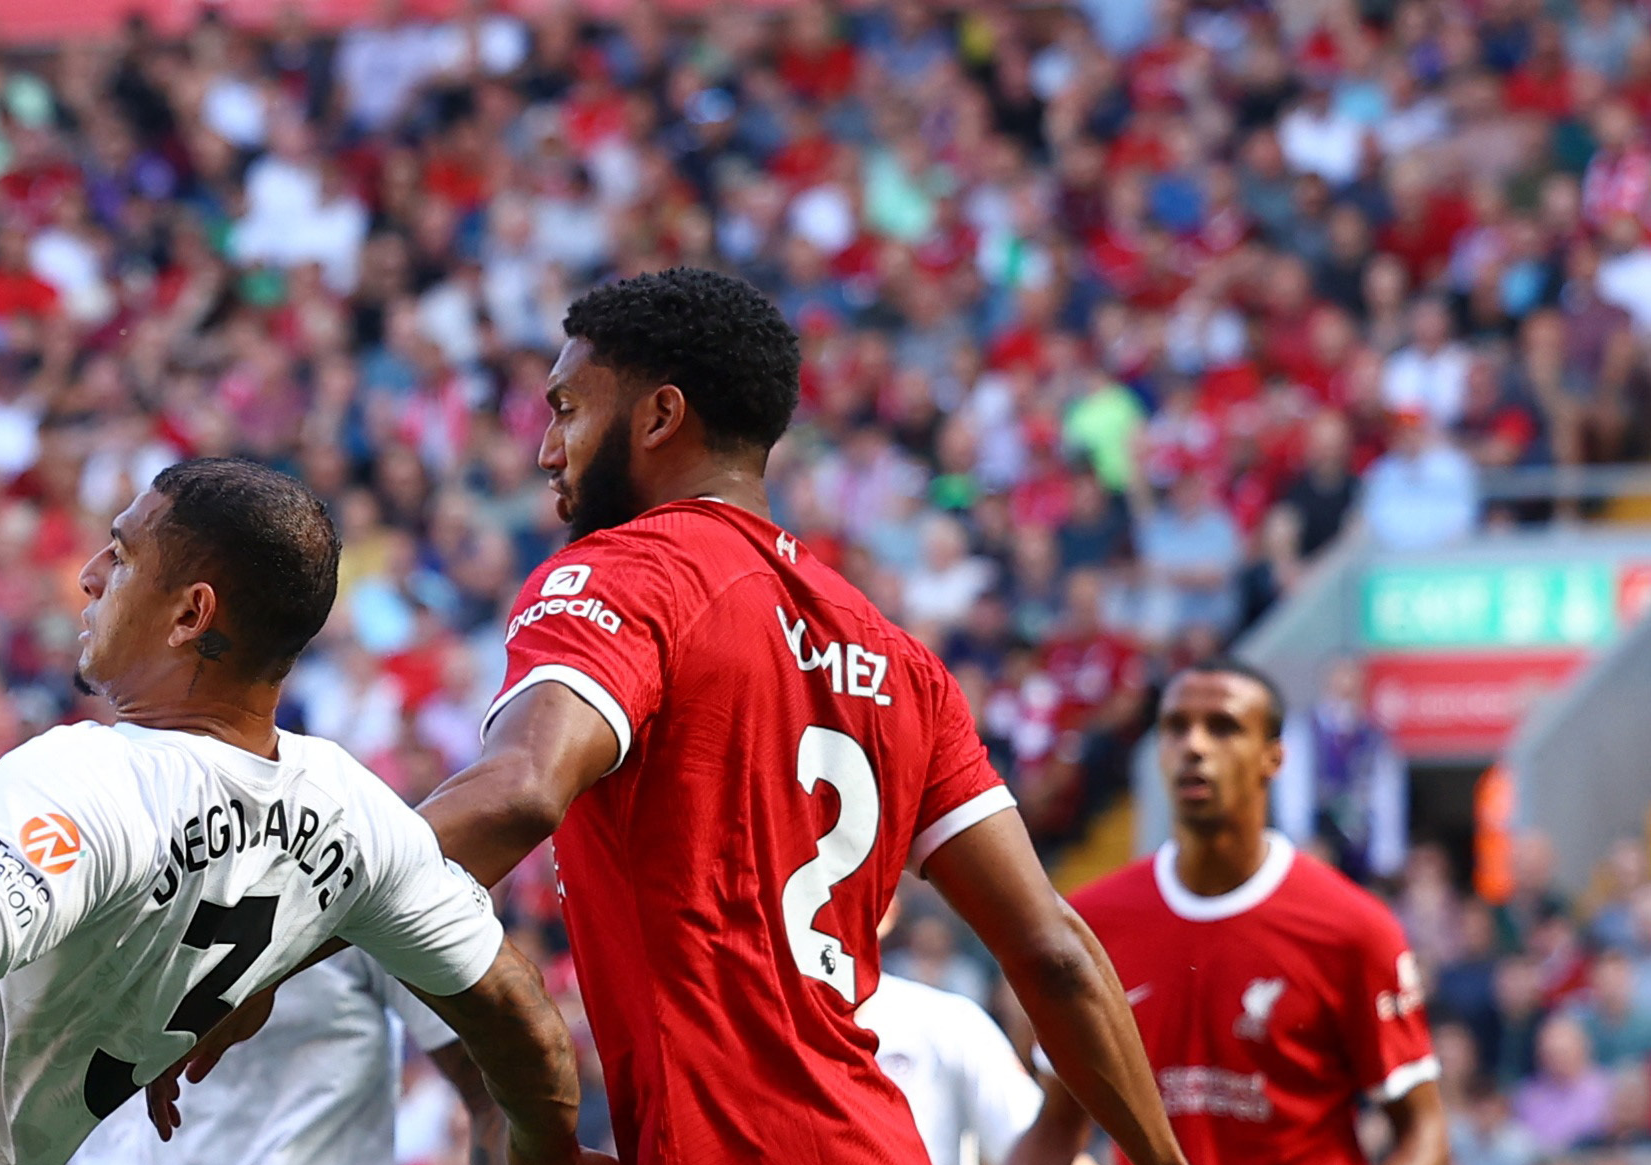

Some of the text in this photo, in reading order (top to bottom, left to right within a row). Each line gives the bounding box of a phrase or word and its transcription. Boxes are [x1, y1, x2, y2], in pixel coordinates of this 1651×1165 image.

[505, 598, 622, 634] Expedia
[249, 799, 354, 912] AROS
[782, 725, 880, 1004] 2
[83, 894, 280, 1120] 3
